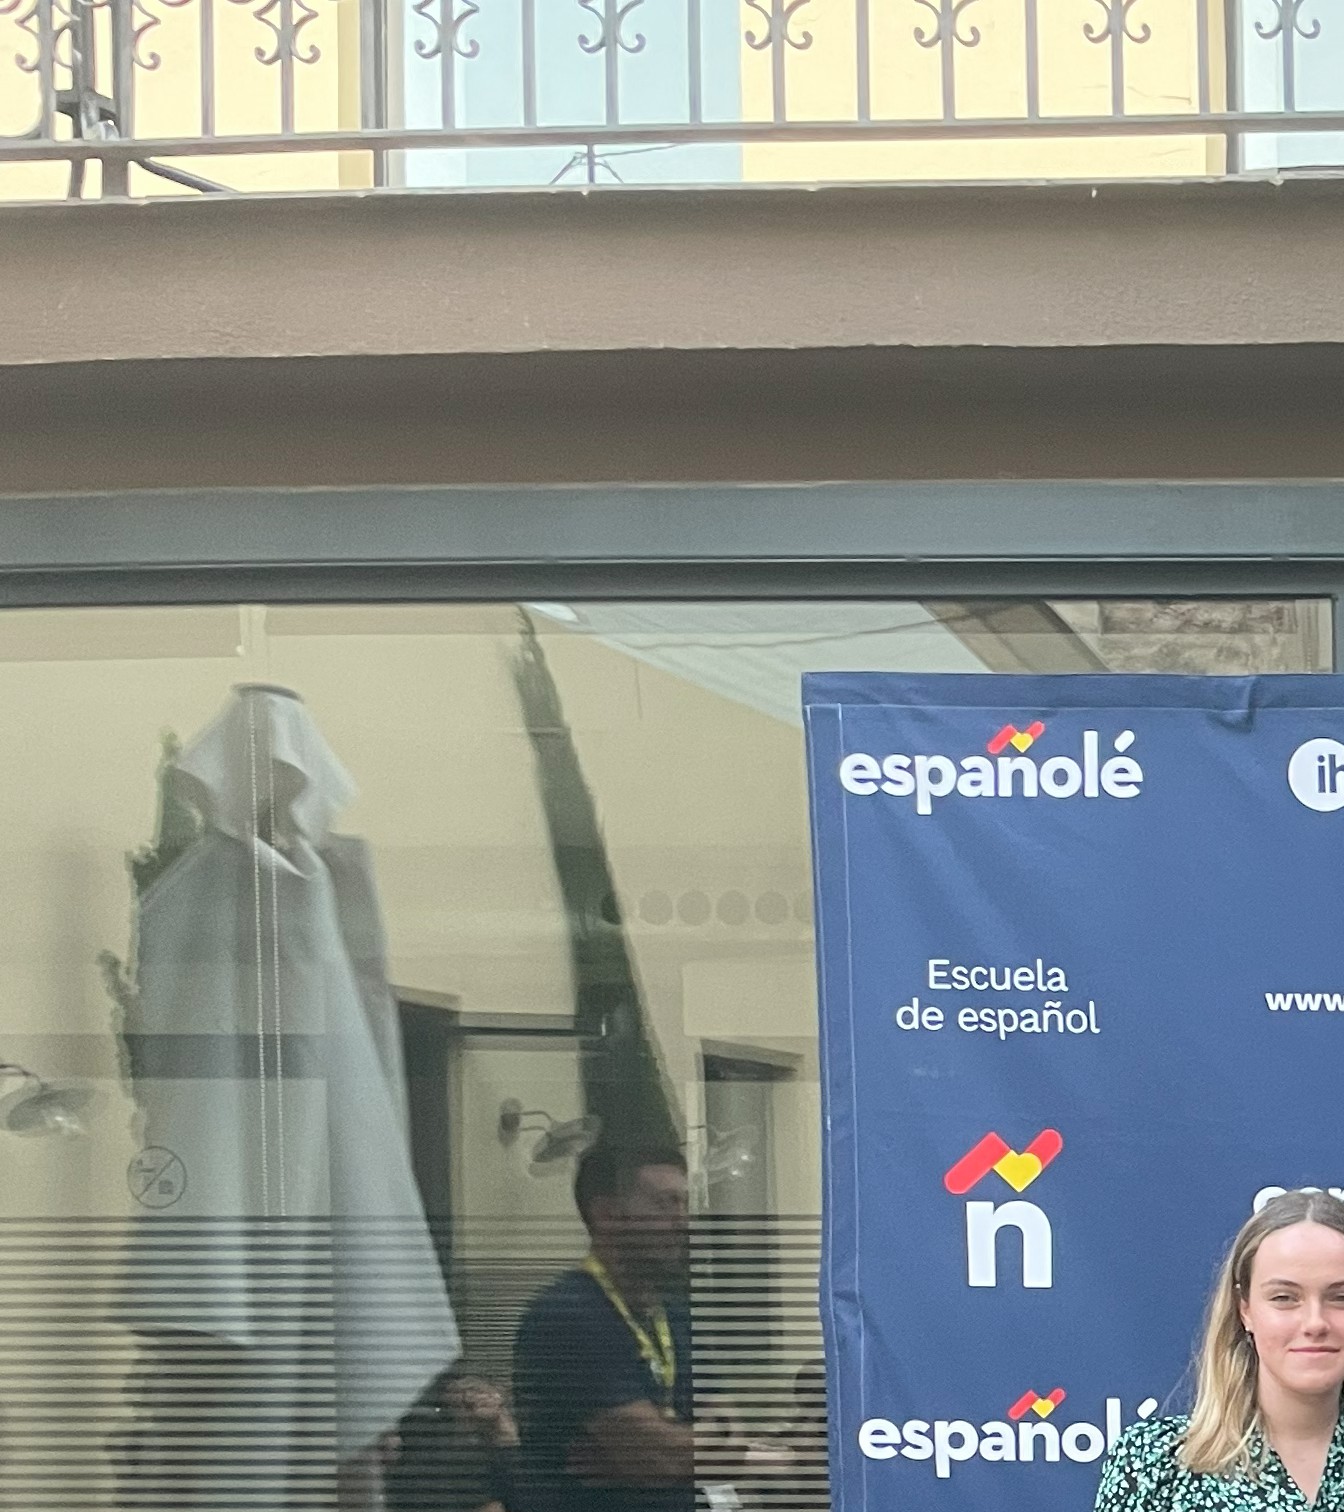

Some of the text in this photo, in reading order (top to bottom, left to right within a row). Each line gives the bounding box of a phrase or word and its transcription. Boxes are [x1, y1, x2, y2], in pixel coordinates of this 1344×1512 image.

[928, 957, 1069, 993] Escuela
[896, 998, 1101, 1041] de español
